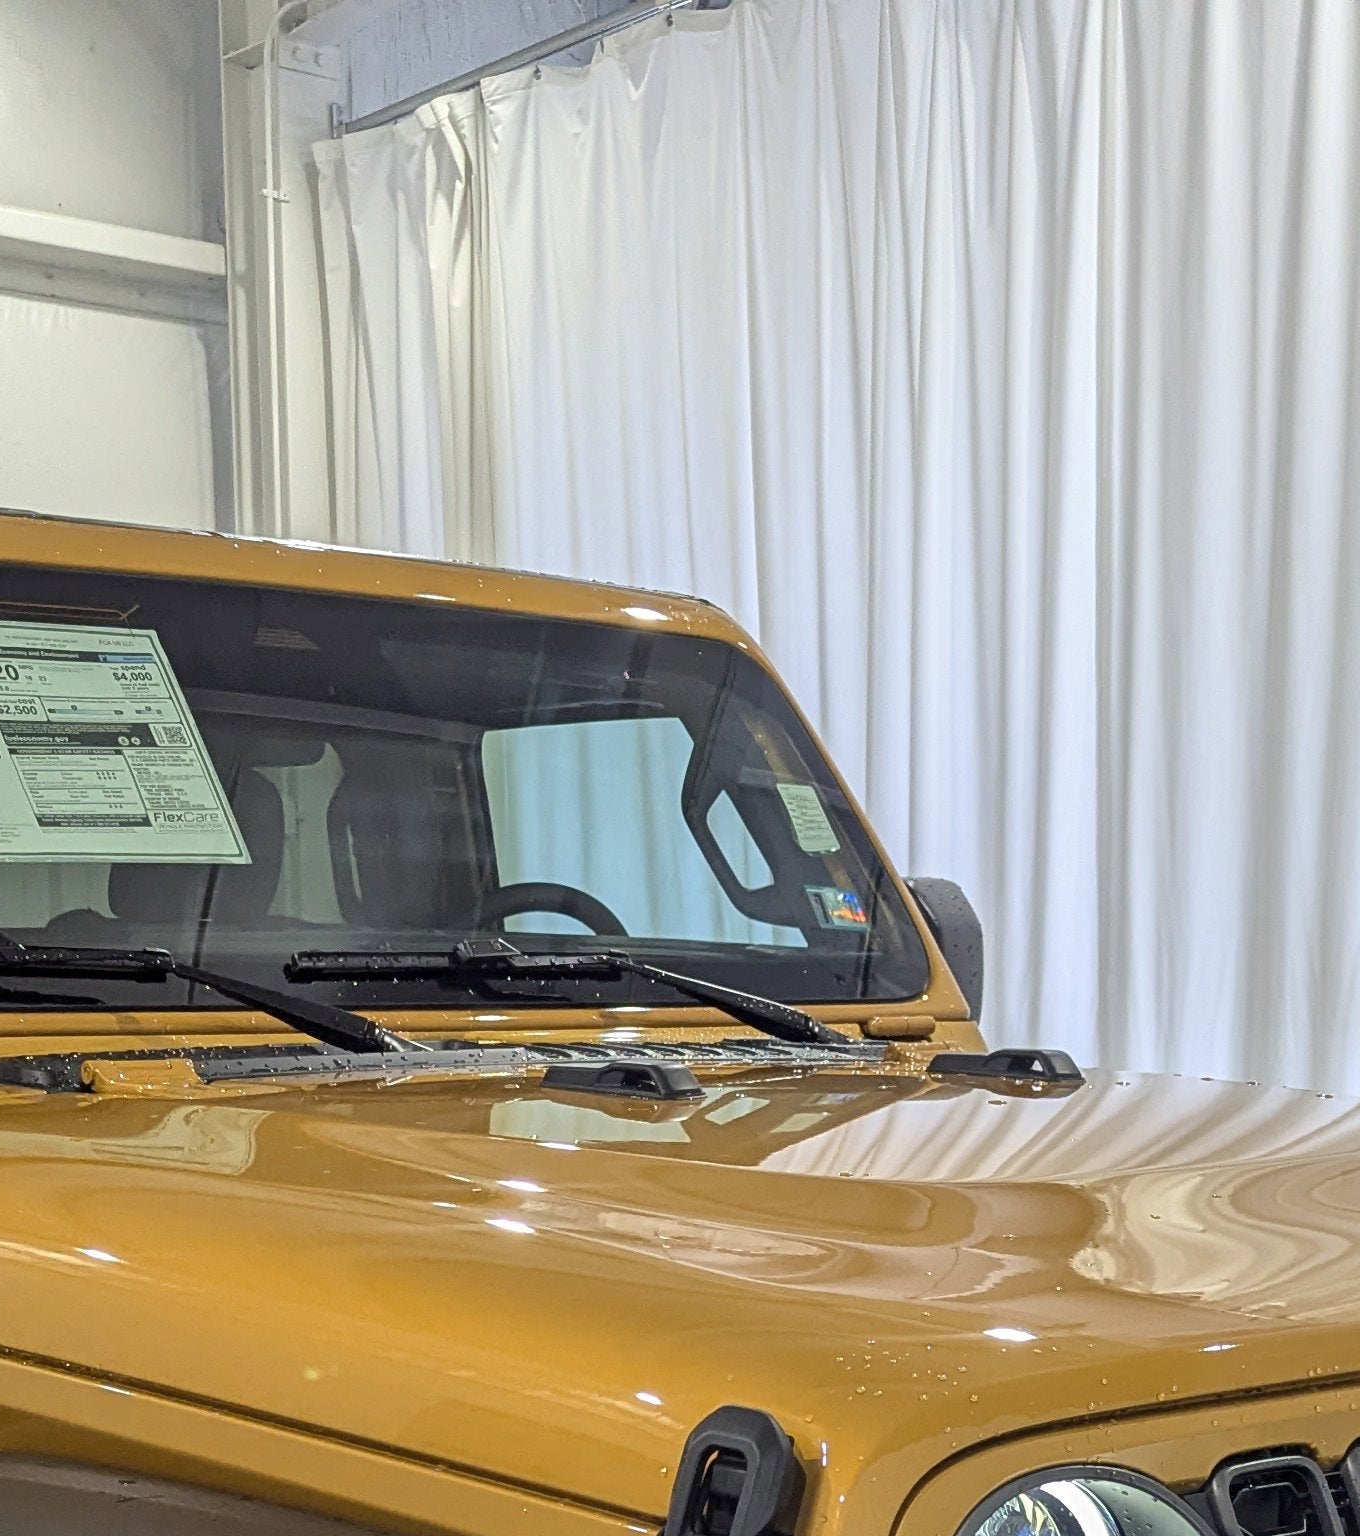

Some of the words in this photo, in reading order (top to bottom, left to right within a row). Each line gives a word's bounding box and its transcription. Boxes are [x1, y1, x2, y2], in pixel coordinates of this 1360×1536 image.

[120, 664, 147, 672] spend
[112, 672, 153, 683] $4,000
[153, 811, 220, 824] FlexCare
